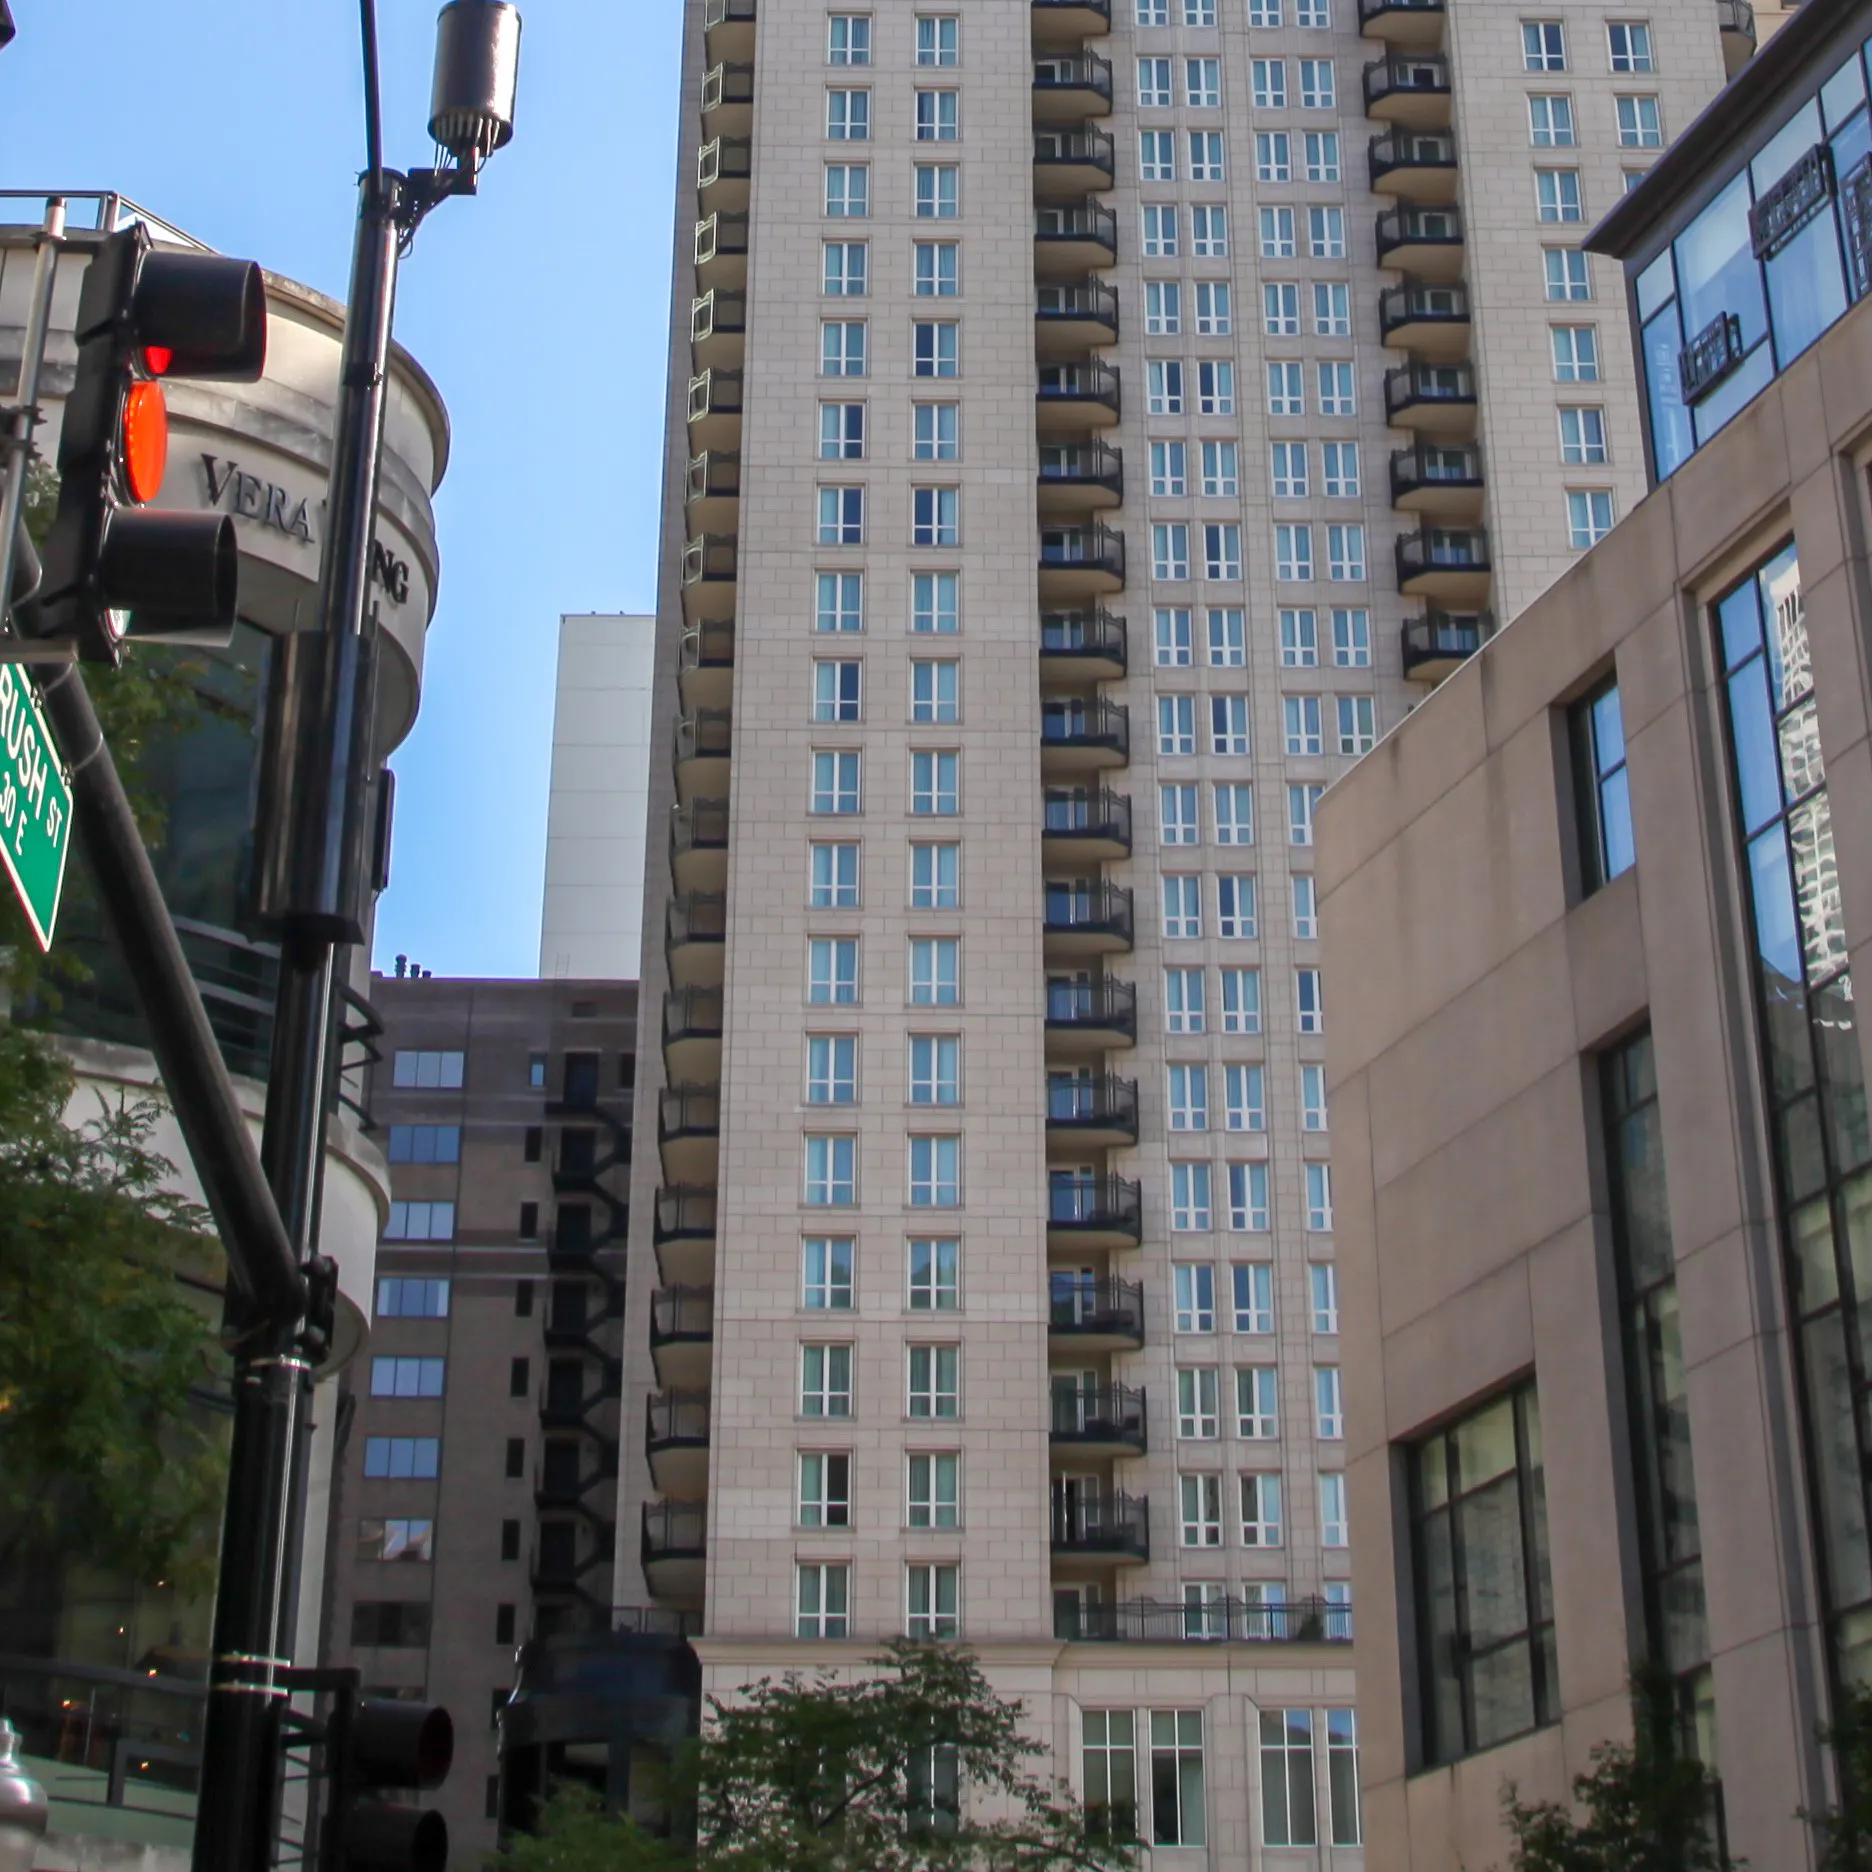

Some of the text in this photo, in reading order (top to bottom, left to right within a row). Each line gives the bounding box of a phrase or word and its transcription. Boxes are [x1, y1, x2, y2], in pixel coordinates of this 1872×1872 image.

[200, 452, 316, 545] VERA
[15, 809, 28, 856] E
[46, 796, 63, 849] ST
